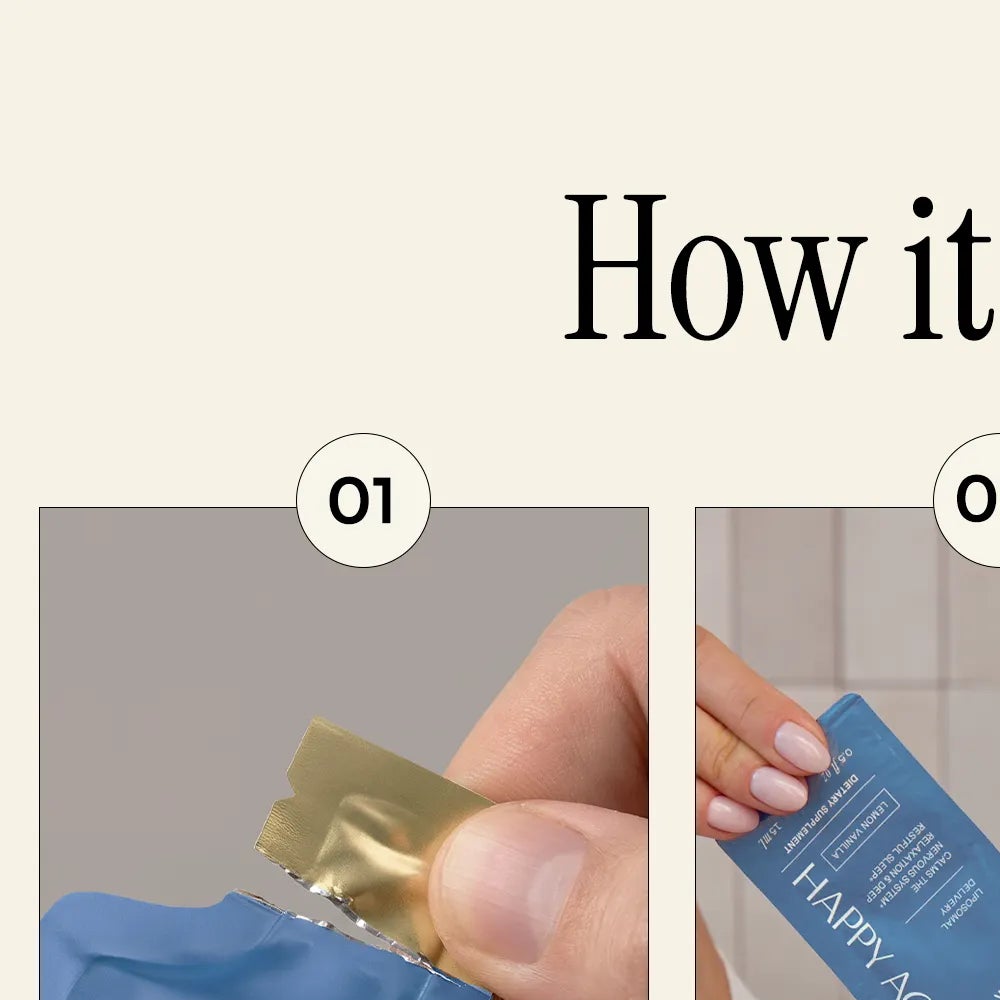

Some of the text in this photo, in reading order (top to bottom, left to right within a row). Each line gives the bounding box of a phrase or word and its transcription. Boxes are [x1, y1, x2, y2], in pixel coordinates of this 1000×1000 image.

[784, 774, 859, 854] DIETARY SUPPLEMENT
[831, 801, 889, 859] LEMON VANILLA
[889, 831, 935, 878] RELAXATION
[892, 822, 926, 854] RESTFUL
[907, 841, 944, 878] NERVOUS
[911, 851, 952, 893] CALMS THE
[866, 880, 886, 903] DEEP
[940, 878, 976, 916] DELIVERY
[940, 888, 984, 930] LIPOSOMAL
[792, 862, 894, 969] HAPPY
